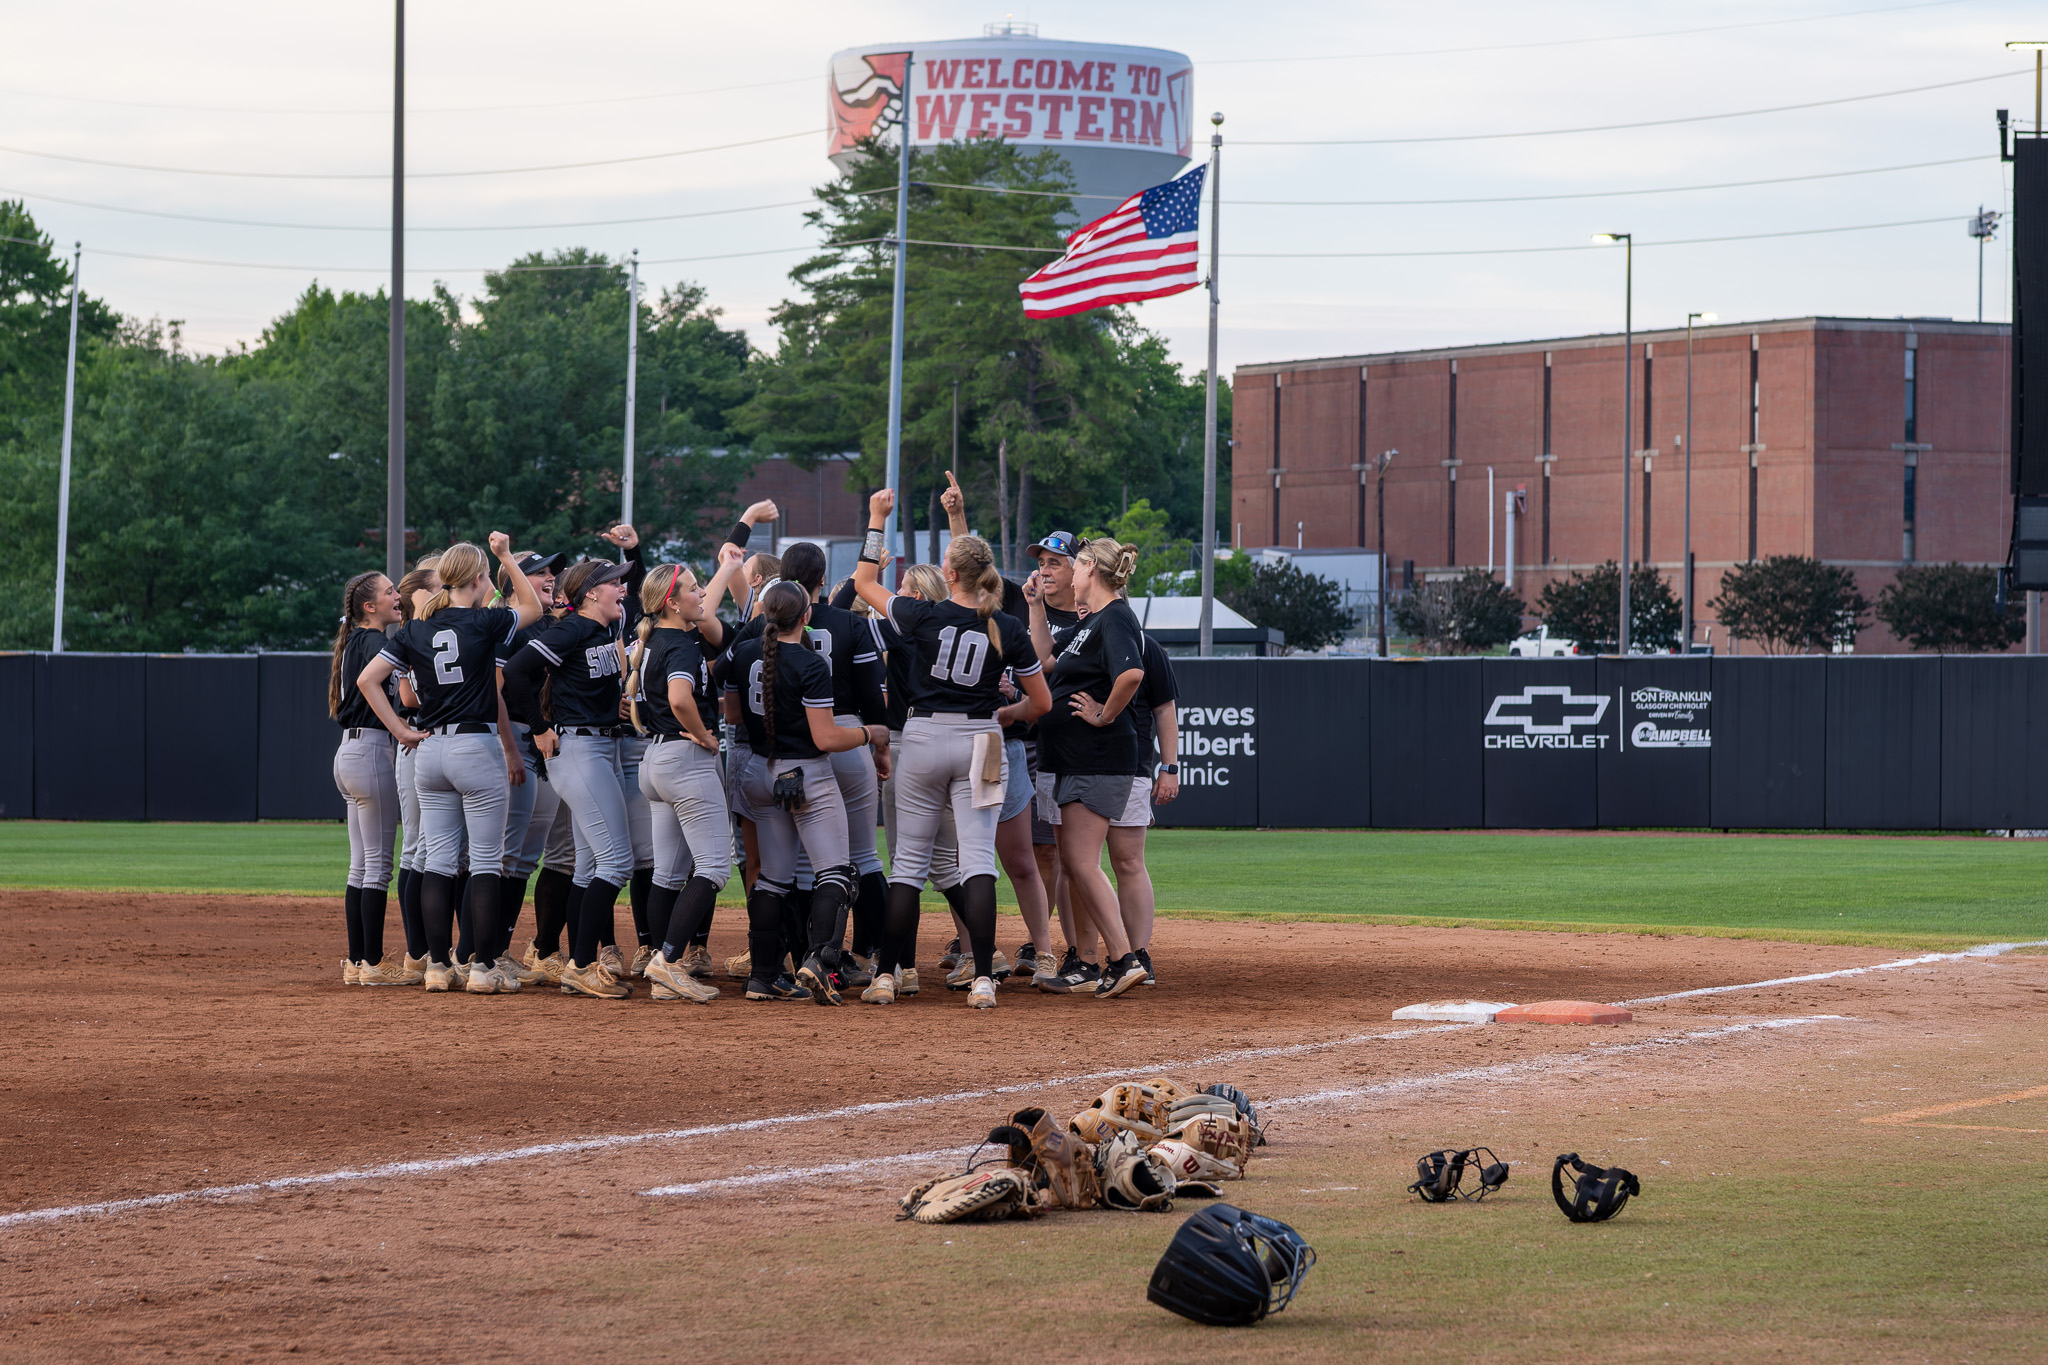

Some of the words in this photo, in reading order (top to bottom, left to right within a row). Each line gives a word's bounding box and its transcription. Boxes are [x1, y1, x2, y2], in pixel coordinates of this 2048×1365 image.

[925, 58, 1116, 93] WELCOME
[1127, 64, 1161, 96] TO
[915, 94, 1165, 146] WESTERN
[432, 629, 464, 685] 2
[930, 625, 989, 687] 10
[1631, 691, 1657, 703] DON
[1659, 691, 1712, 702] FRANKLIN
[1635, 702, 1668, 710] GLASGOW
[1669, 702, 1708, 710] CHEVROLET
[1177, 707, 1256, 726] raves
[1153, 731, 1256, 756] ilbert
[1484, 735, 1610, 749] CHEVROLET
[1631, 721, 1712, 748] CAMPBELL
[1153, 761, 1230, 786] linic
